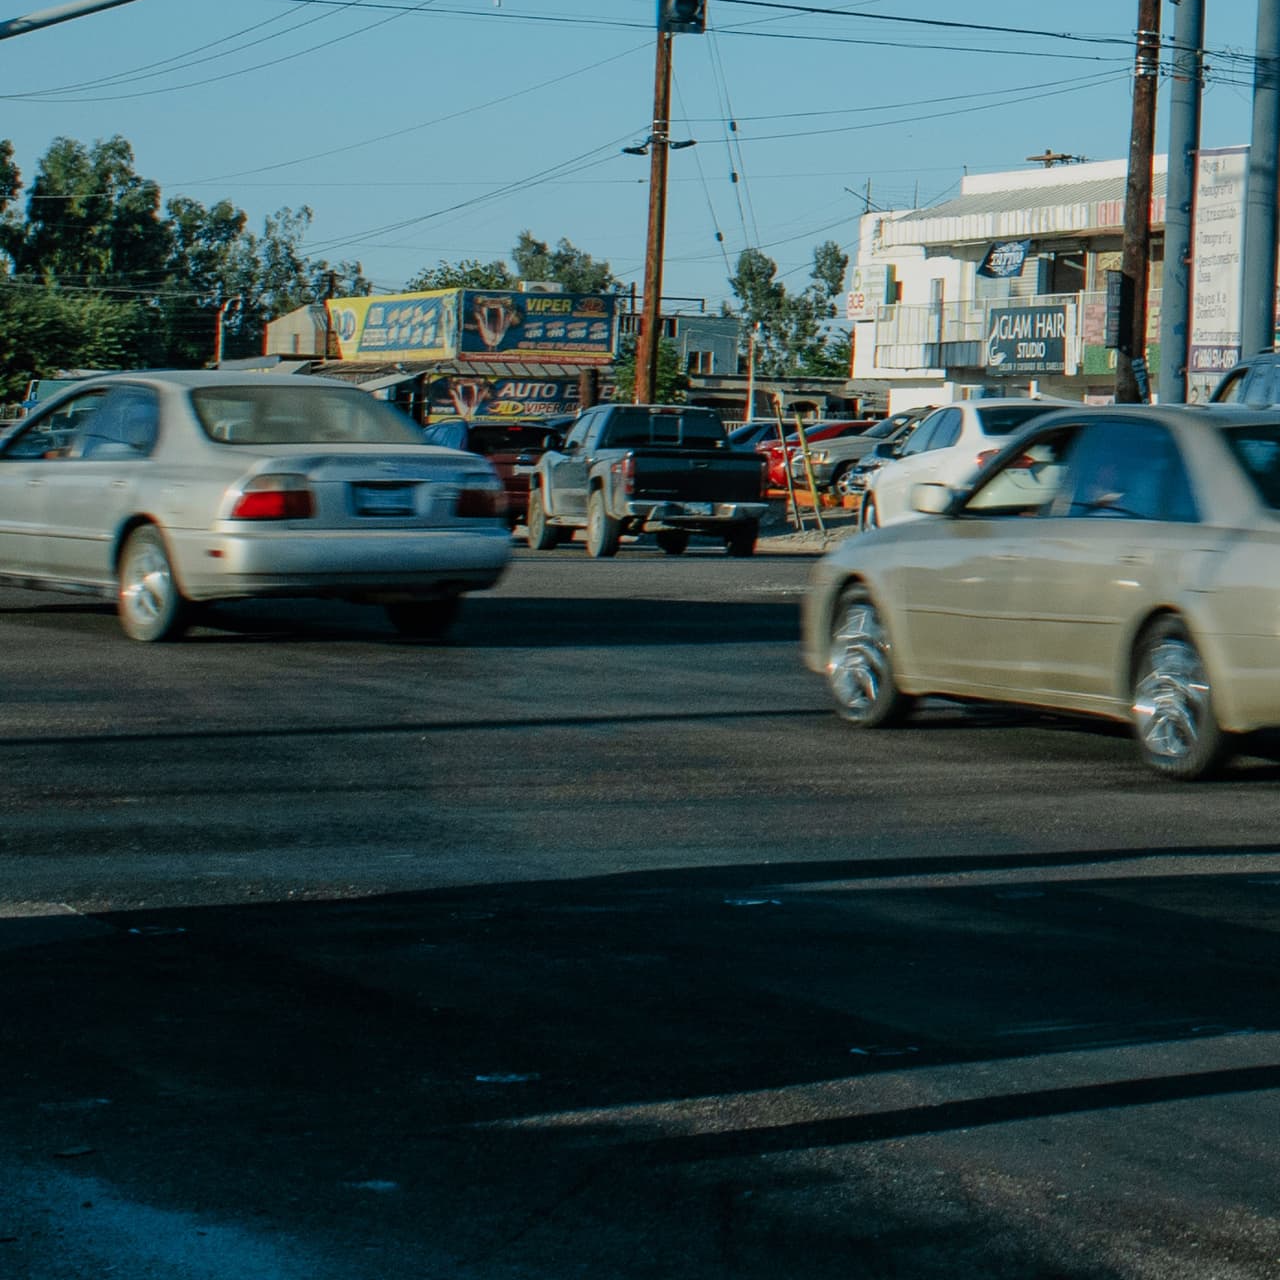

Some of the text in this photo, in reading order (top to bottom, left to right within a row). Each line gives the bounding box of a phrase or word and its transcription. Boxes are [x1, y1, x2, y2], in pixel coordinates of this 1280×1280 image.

[526, 298, 572, 312] VIPER
[1000, 314, 1031, 339] GLAM
[1035, 312, 1066, 338] HAIR
[1016, 342, 1046, 358] STUDIO
[499, 382, 557, 398] AUTO
[524, 401, 561, 414] VIPER
